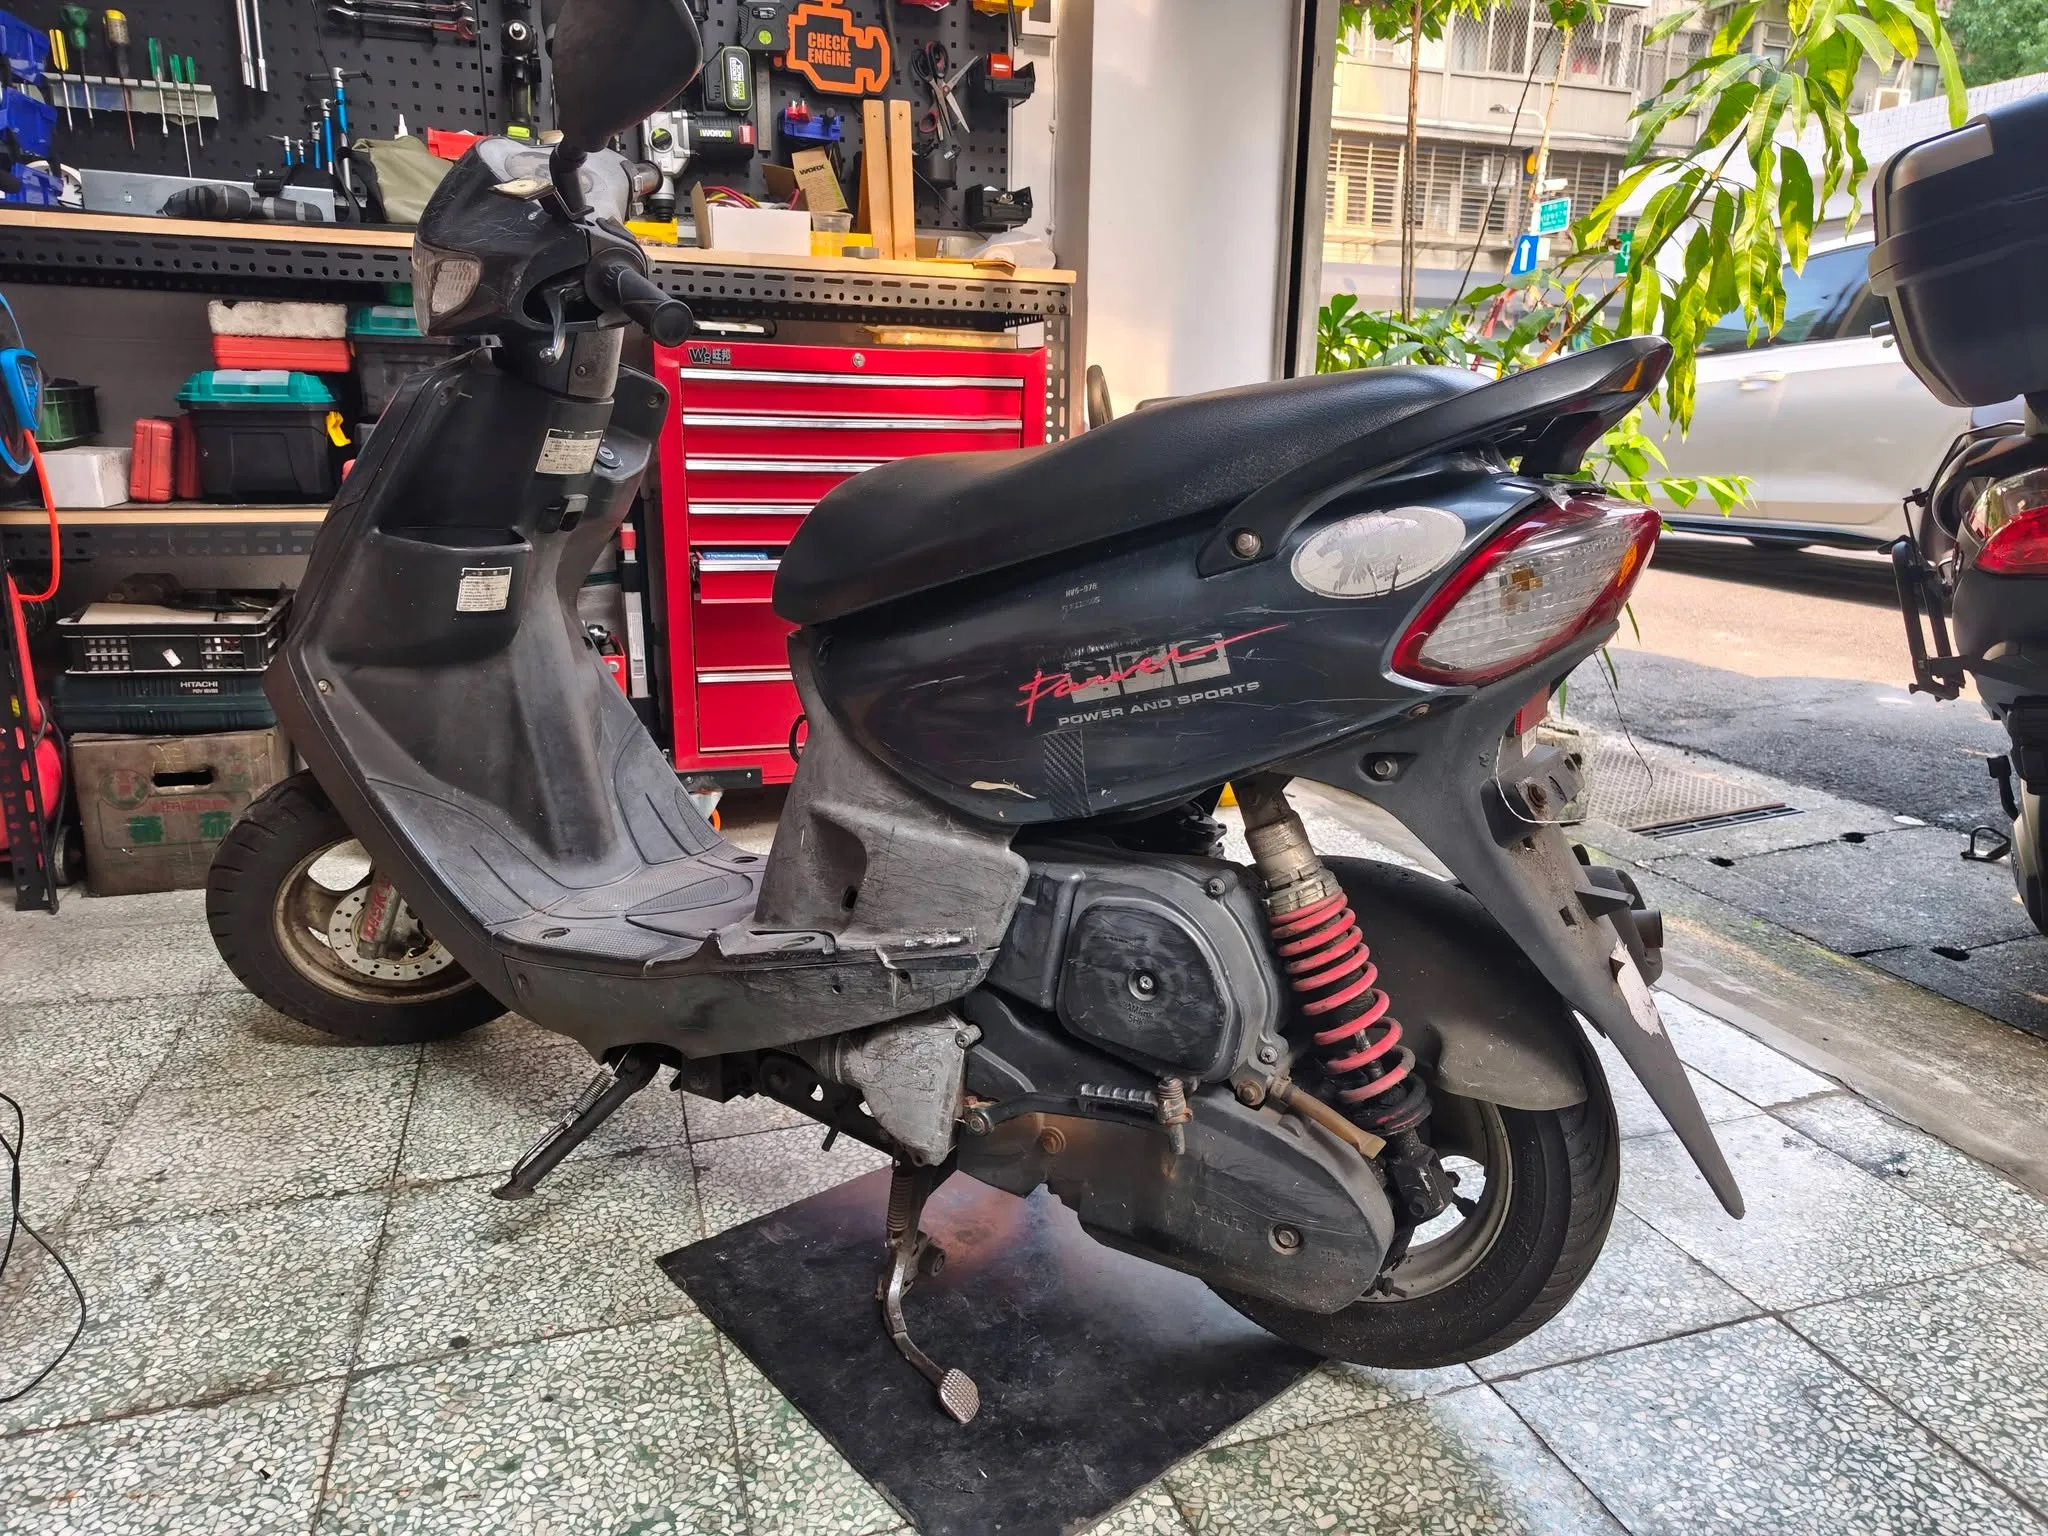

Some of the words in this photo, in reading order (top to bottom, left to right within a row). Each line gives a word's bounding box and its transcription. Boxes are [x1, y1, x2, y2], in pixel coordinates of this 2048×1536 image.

[807, 32, 850, 51] CHECK
[807, 47, 852, 68] ENGINE
[701, 129, 727, 137] WORX
[799, 164, 825, 175] WORX
[1058, 706, 1124, 727] POWER
[1130, 699, 1172, 715] AND
[1177, 681, 1261, 706] SPORTS
